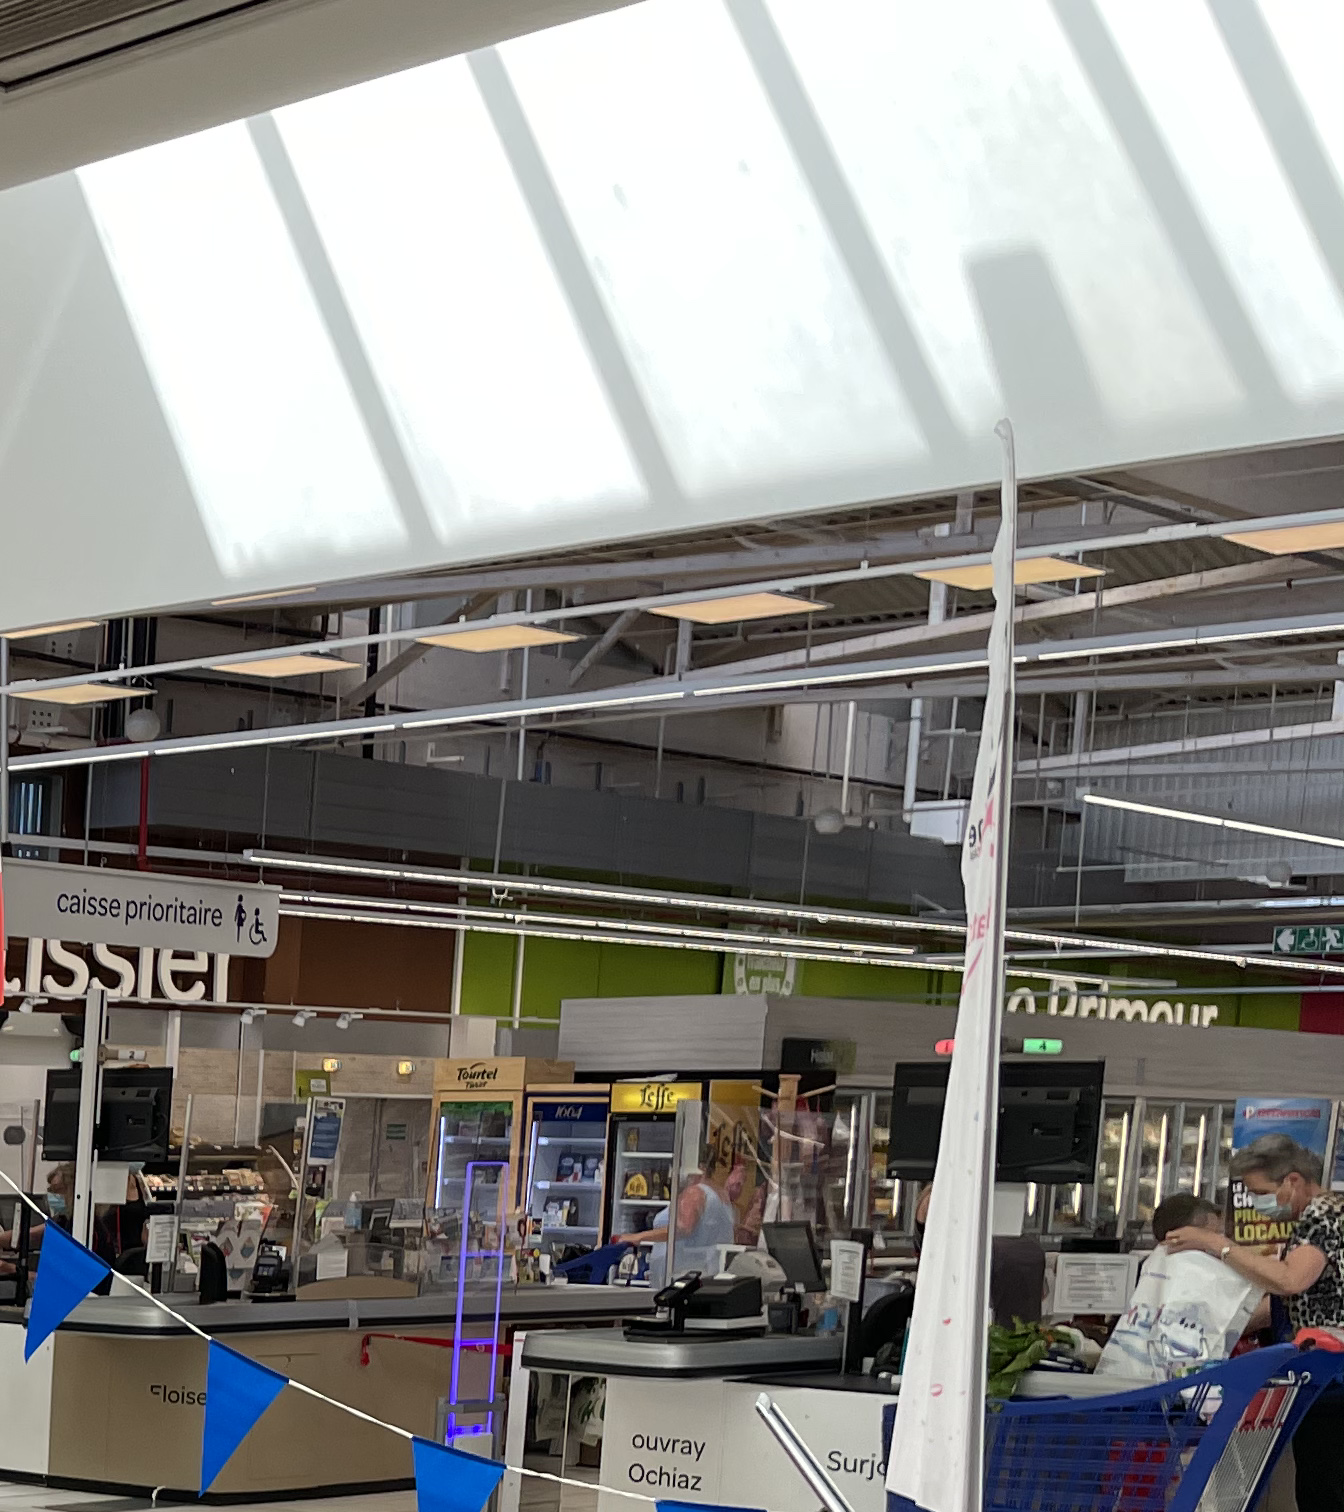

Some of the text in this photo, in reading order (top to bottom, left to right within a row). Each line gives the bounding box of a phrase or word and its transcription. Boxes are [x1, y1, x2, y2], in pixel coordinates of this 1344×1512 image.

[56, 888, 223, 927] caisse prioritaire
[457, 1067, 499, 1080] Tourtel
[640, 1083, 674, 1110] Leffe
[1234, 1221, 1296, 1242] LOCAU
[632, 1434, 706, 1462] ouvray
[629, 1463, 702, 1491] Ochiaz
